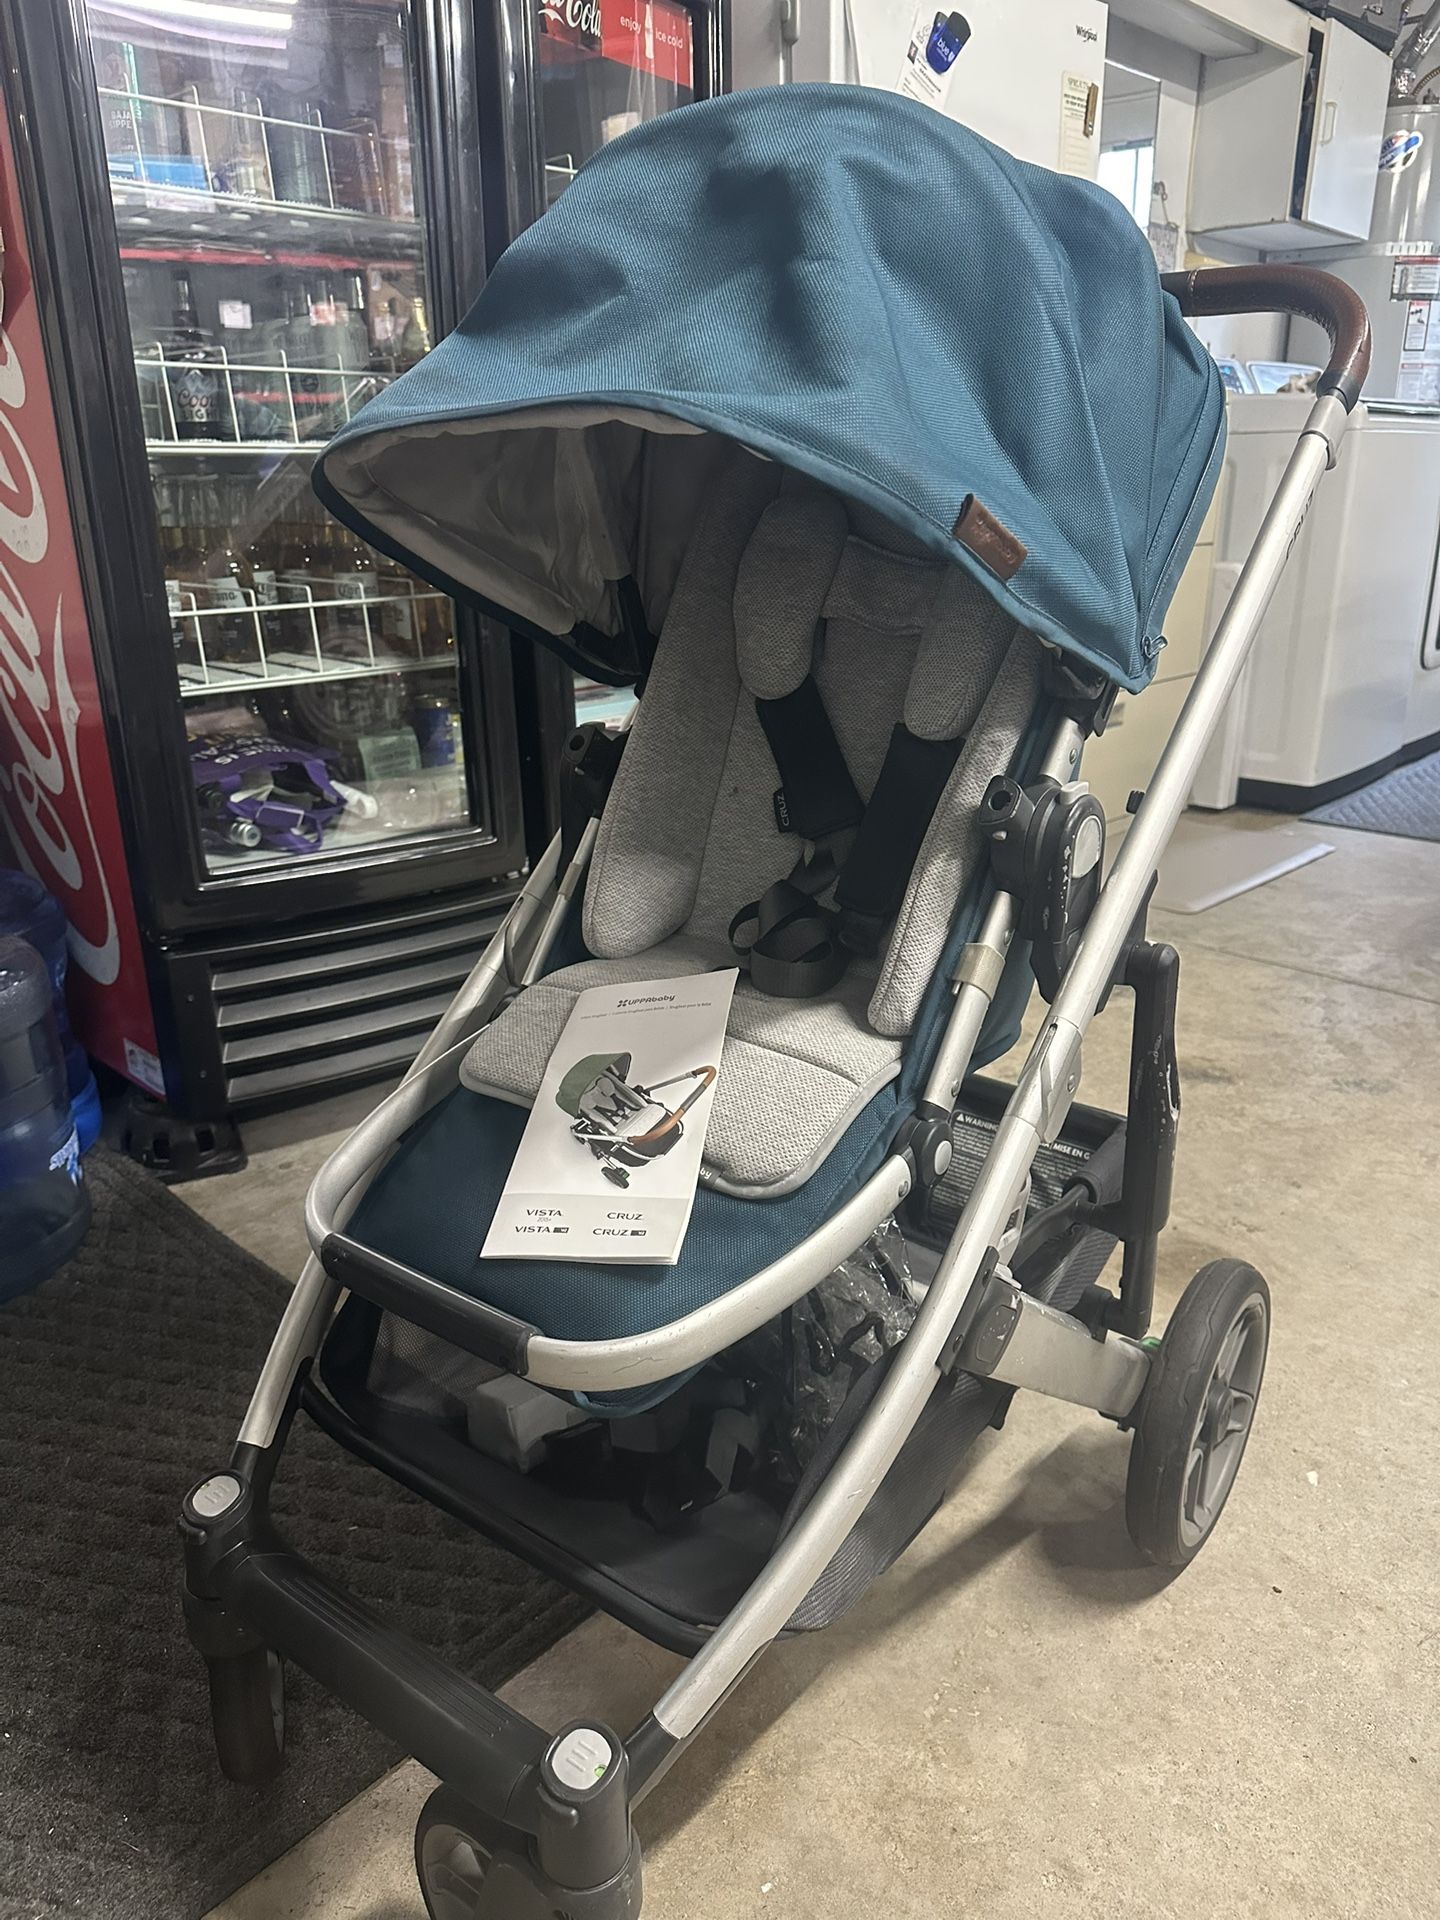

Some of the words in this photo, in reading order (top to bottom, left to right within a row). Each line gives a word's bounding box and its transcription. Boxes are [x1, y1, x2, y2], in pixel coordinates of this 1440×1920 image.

[620, 16, 641, 34] enjoy
[655, 28, 667, 42] ice
[667, 34, 683, 49] cold
[777, 791, 790, 827] CRUZ
[1053, 1143, 1072, 1154] MISE
[1072, 1148, 1083, 1158] EN
[526, 1209, 563, 1217] VISTA
[607, 1212, 643, 1221] CRUZ
[514, 1226, 552, 1234] VISTA
[592, 1228, 629, 1237] CRUZ
